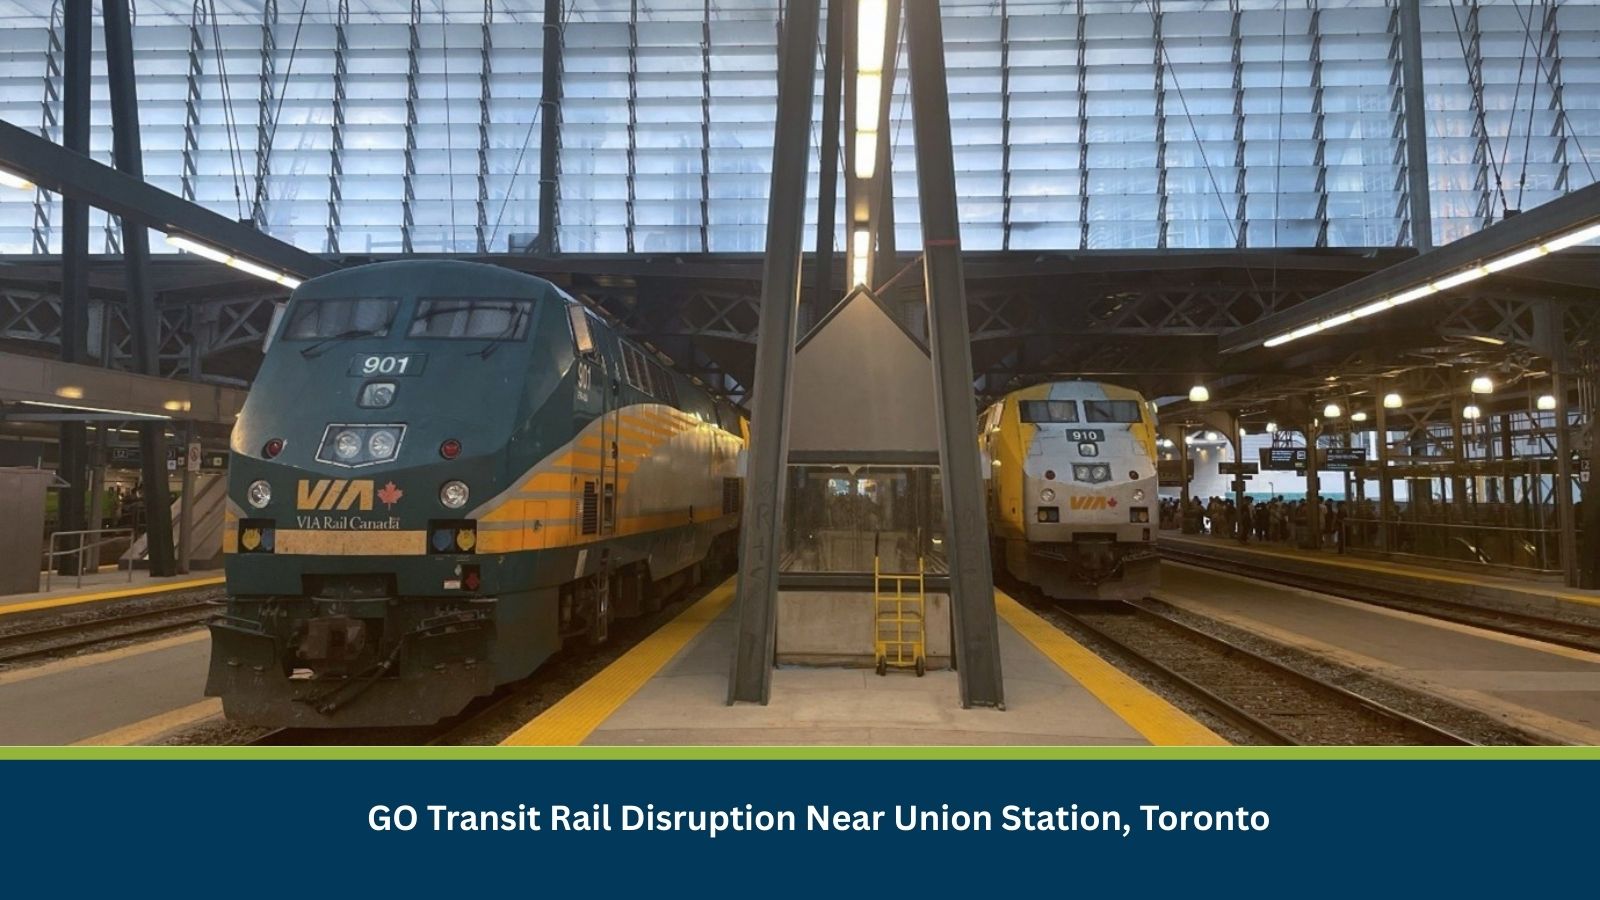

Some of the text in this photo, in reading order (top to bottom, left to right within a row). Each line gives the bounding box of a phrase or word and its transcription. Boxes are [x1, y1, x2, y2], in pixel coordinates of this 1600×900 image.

[362, 356, 409, 374] 901
[1072, 431, 1098, 440] 910
[297, 479, 375, 511] VIA
[1070, 496, 1106, 510] VIA
[296, 516, 400, 530] VIA Rail Canada
